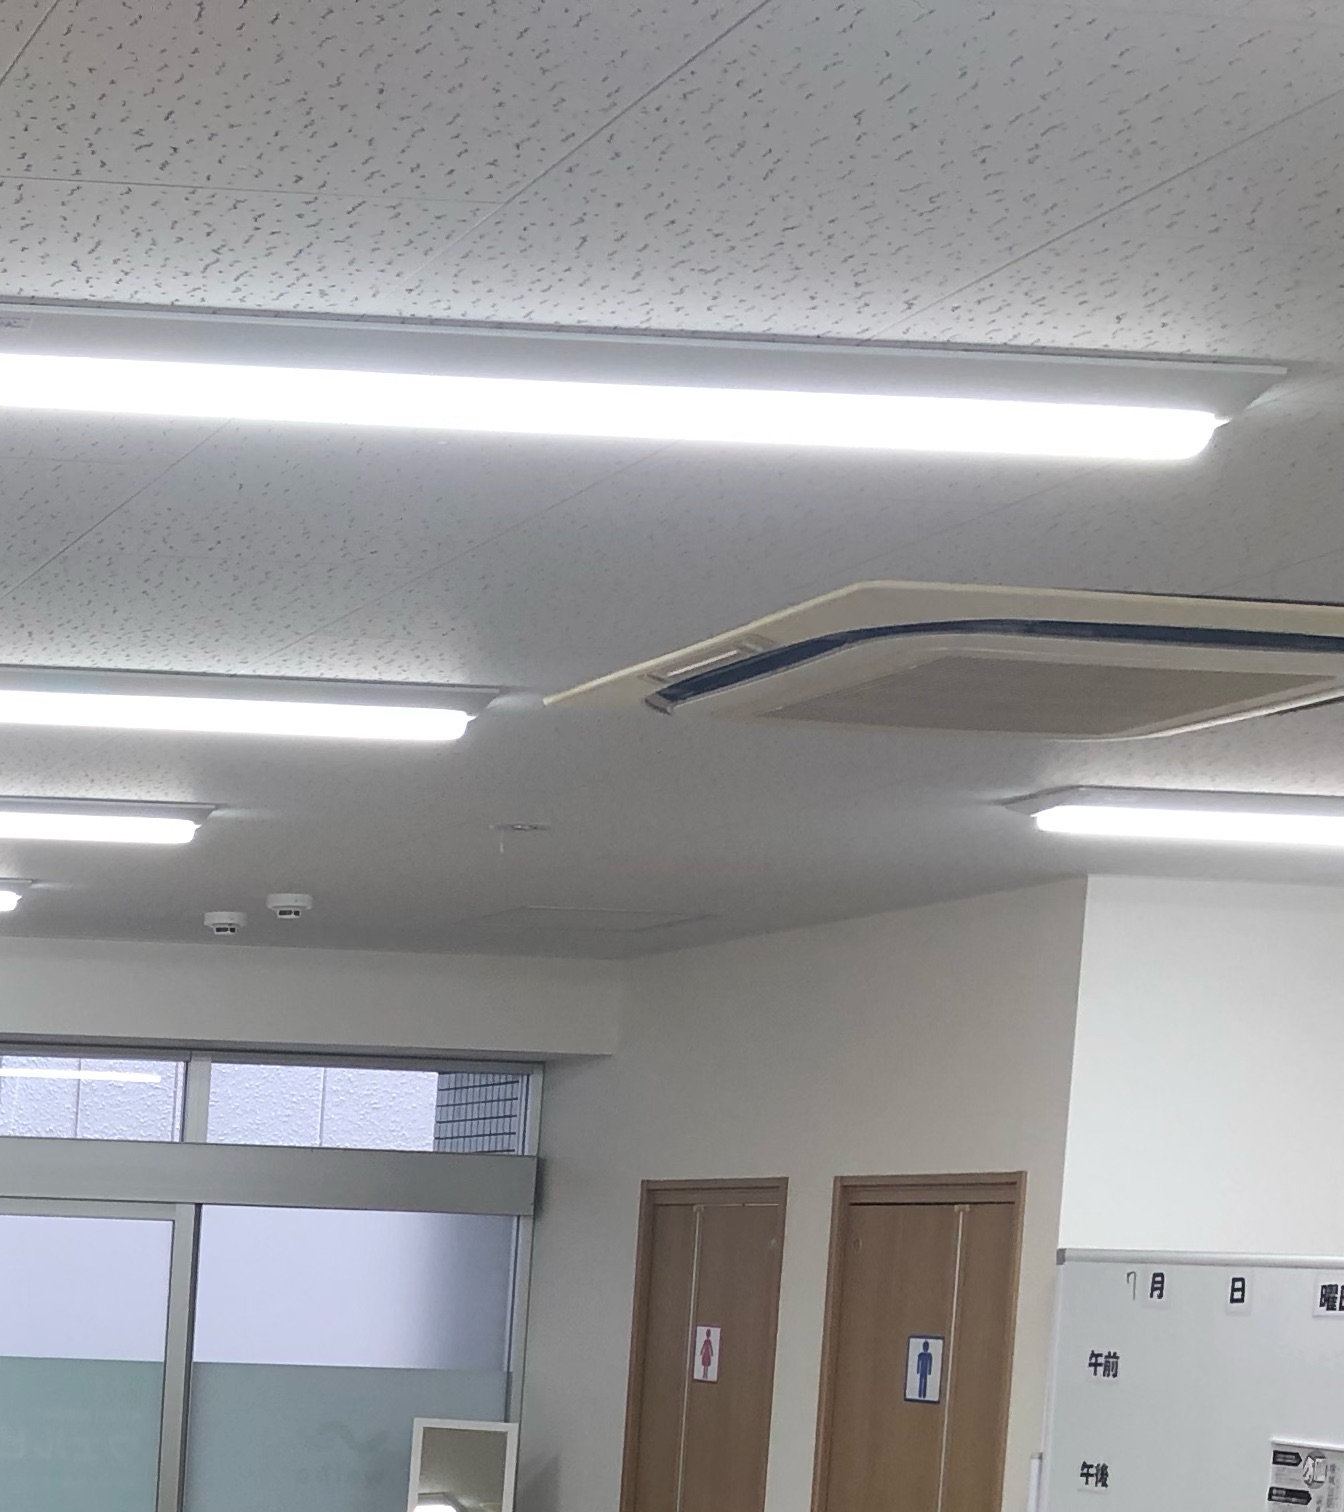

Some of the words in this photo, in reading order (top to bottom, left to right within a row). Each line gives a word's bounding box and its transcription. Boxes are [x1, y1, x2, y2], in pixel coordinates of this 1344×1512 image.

[1149, 1272, 1165, 1300] 月
[1229, 1277, 1246, 1304] 日
[1088, 1349, 1120, 1378] 午前
[1080, 1460, 1109, 1488] 午後
